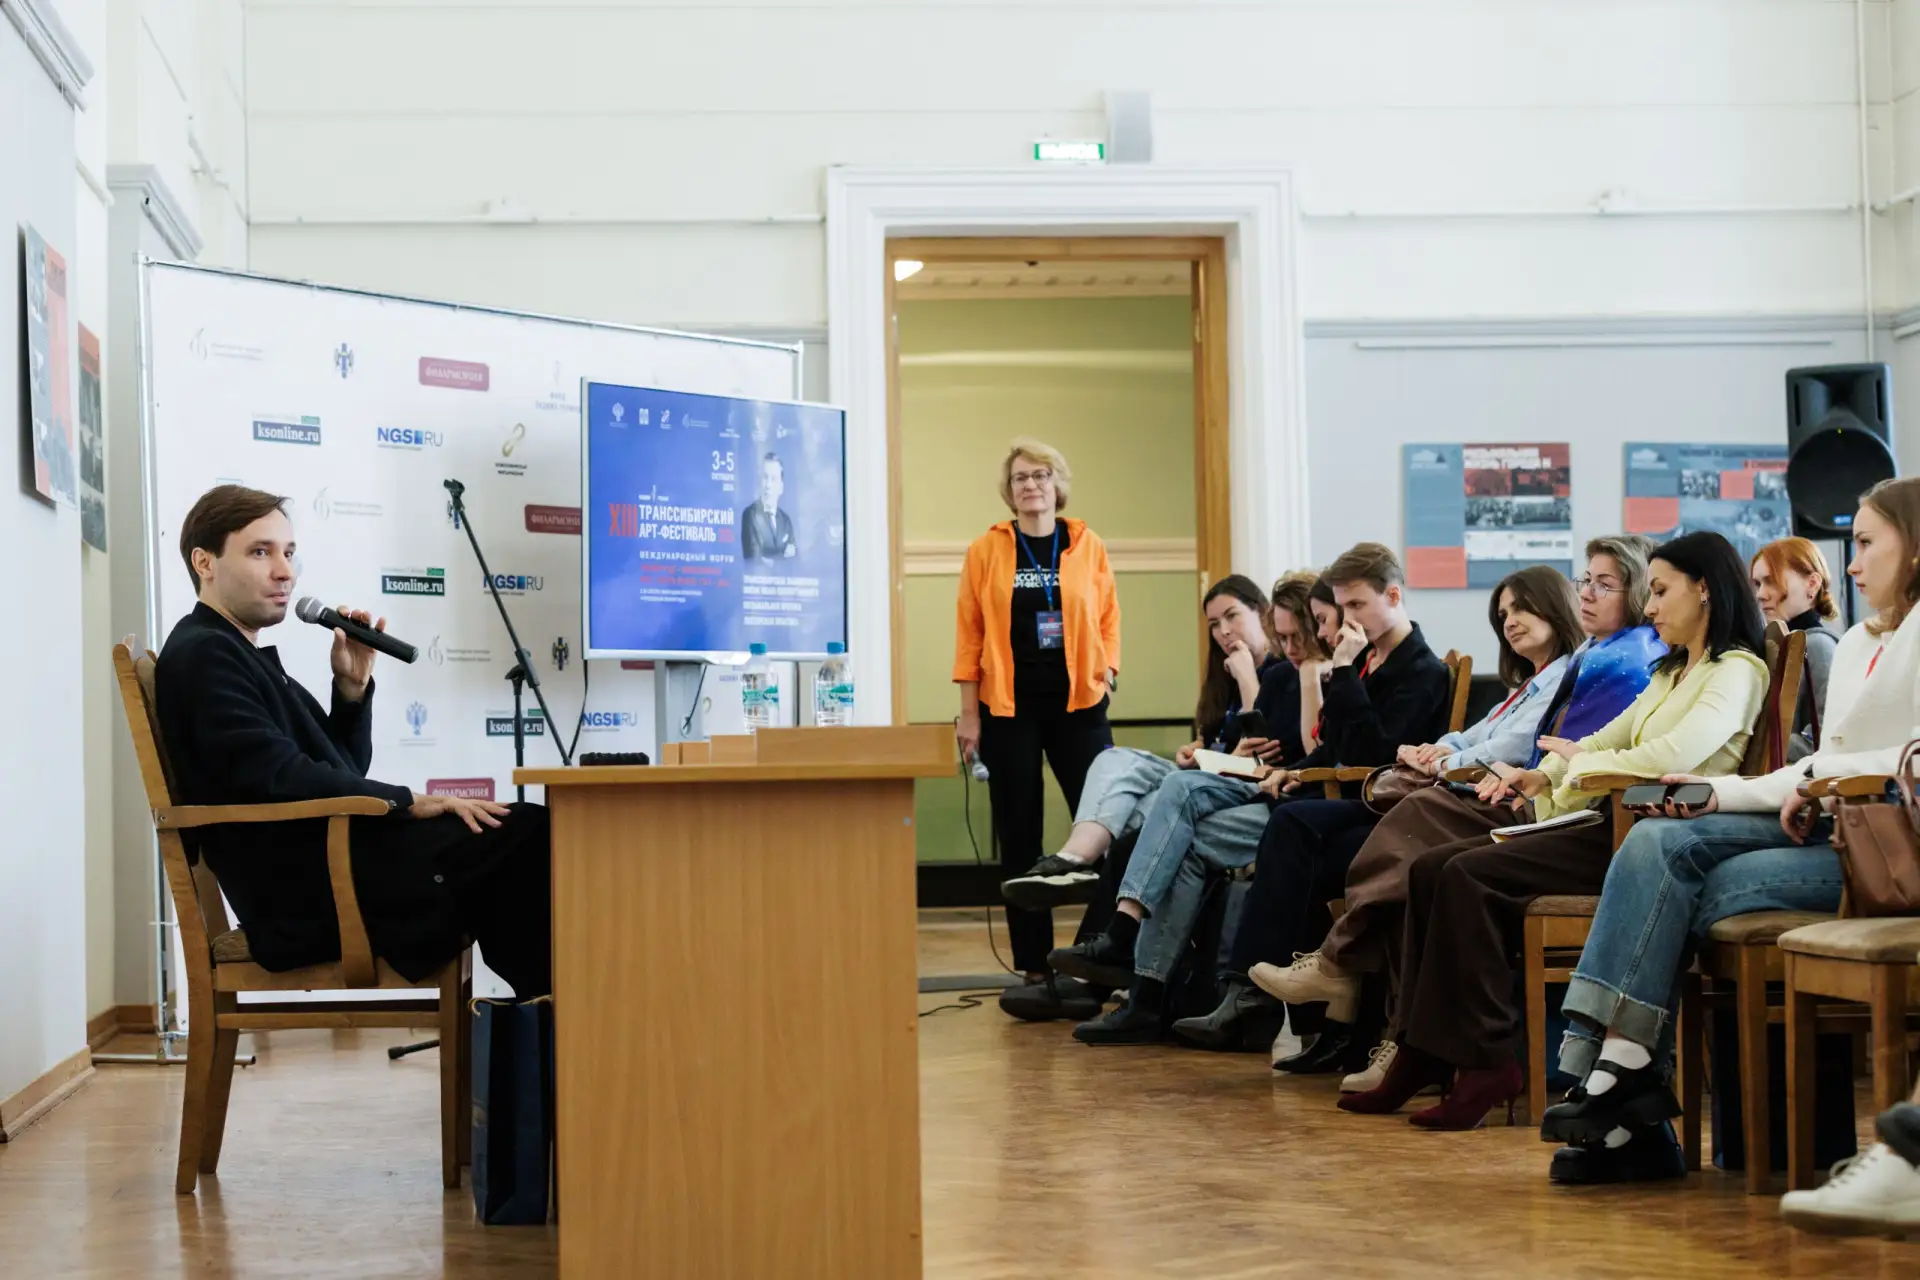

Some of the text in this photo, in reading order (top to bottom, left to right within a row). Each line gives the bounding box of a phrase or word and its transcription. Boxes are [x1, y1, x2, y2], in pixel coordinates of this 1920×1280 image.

[257, 423, 319, 442] ksonline.ru
[711, 450, 734, 471] 3-5
[531, 514, 581, 526] ФИЛАРМОНИ
[638, 504, 734, 525] ТРАНССИБИРСКИЙ
[639, 522, 716, 542] АРТ-ФЕСТИВАЛЬ
[386, 577, 444, 593] ksonline.ru
